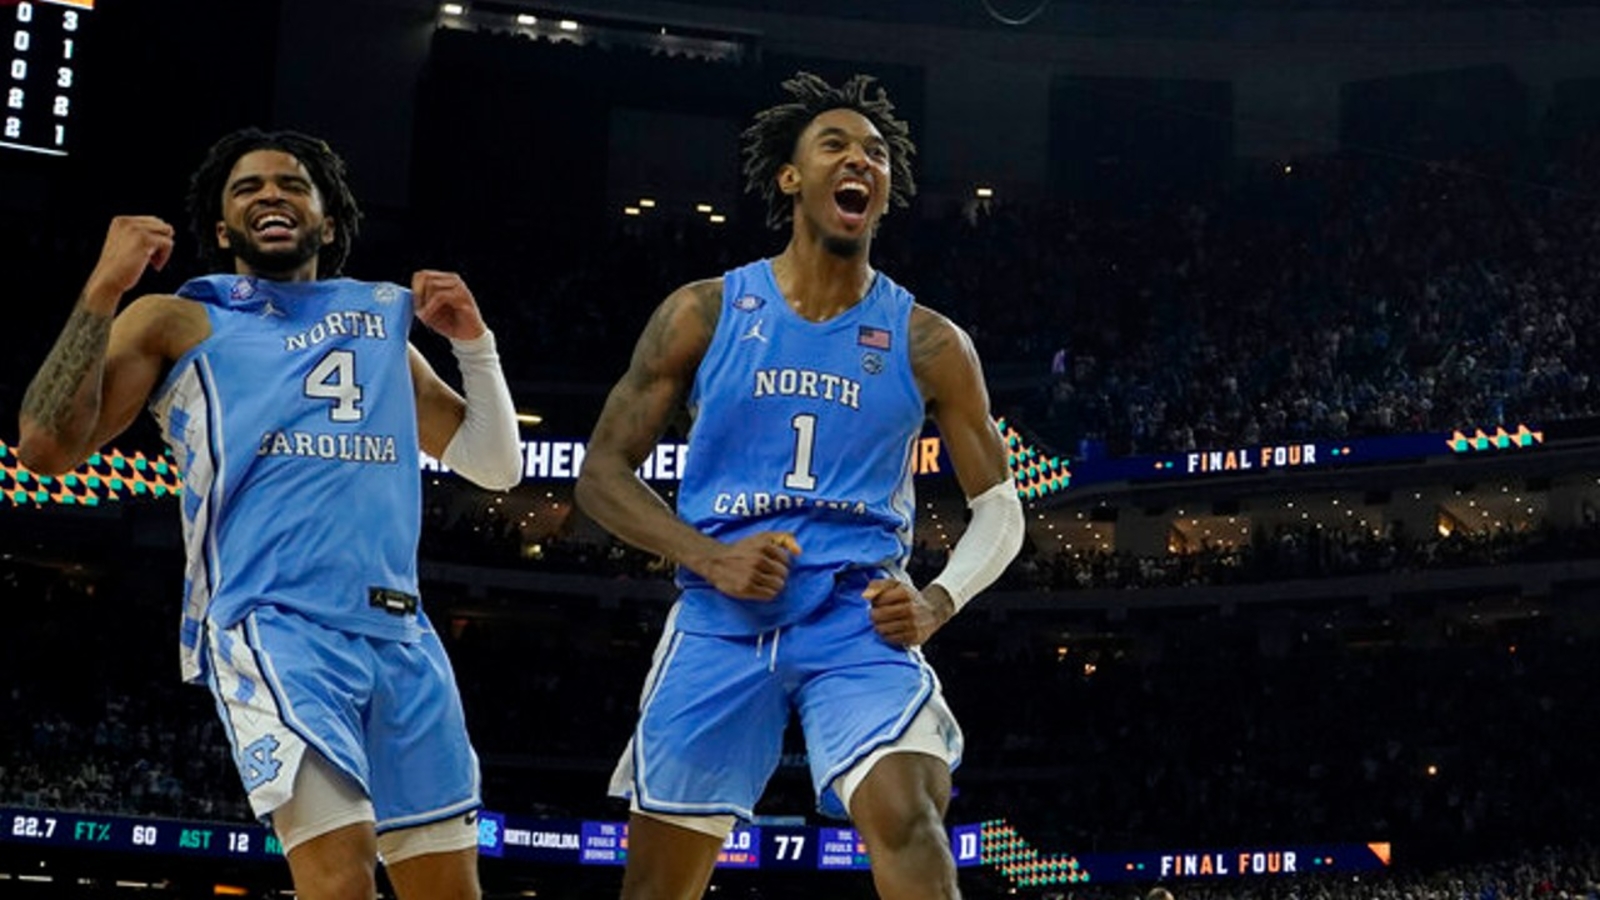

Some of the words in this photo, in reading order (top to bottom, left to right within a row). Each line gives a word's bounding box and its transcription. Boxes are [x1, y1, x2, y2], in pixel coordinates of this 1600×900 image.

[17, 2, 32, 22] 0
[62, 10, 79, 31] 3
[14, 30, 30, 51] 0
[63, 38, 73, 59] 1
[11, 59, 27, 80] 0
[57, 66, 73, 88] 3
[8, 86, 24, 109] 2
[53, 95, 69, 116] 2
[5, 116, 21, 138] 2
[55, 124, 64, 145] 1
[286, 311, 387, 350] NORTH
[305, 349, 363, 422] 4
[754, 369, 861, 409] NORTH
[257, 431, 397, 462] CAROLINA
[783, 412, 818, 491] 1
[1187, 450, 1251, 473] FINAL
[1261, 444, 1316, 468] FOUR
[12, 816, 57, 837] 22.7
[74, 821, 112, 841] FT%
[132, 825, 157, 845] 60
[179, 829, 213, 849] AST
[229, 832, 249, 852] 12
[532, 831, 580, 850] CAROLINA
[774, 835, 805, 860] 77
[1161, 855, 1228, 877] FINAL
[1239, 851, 1297, 874] FOUR
